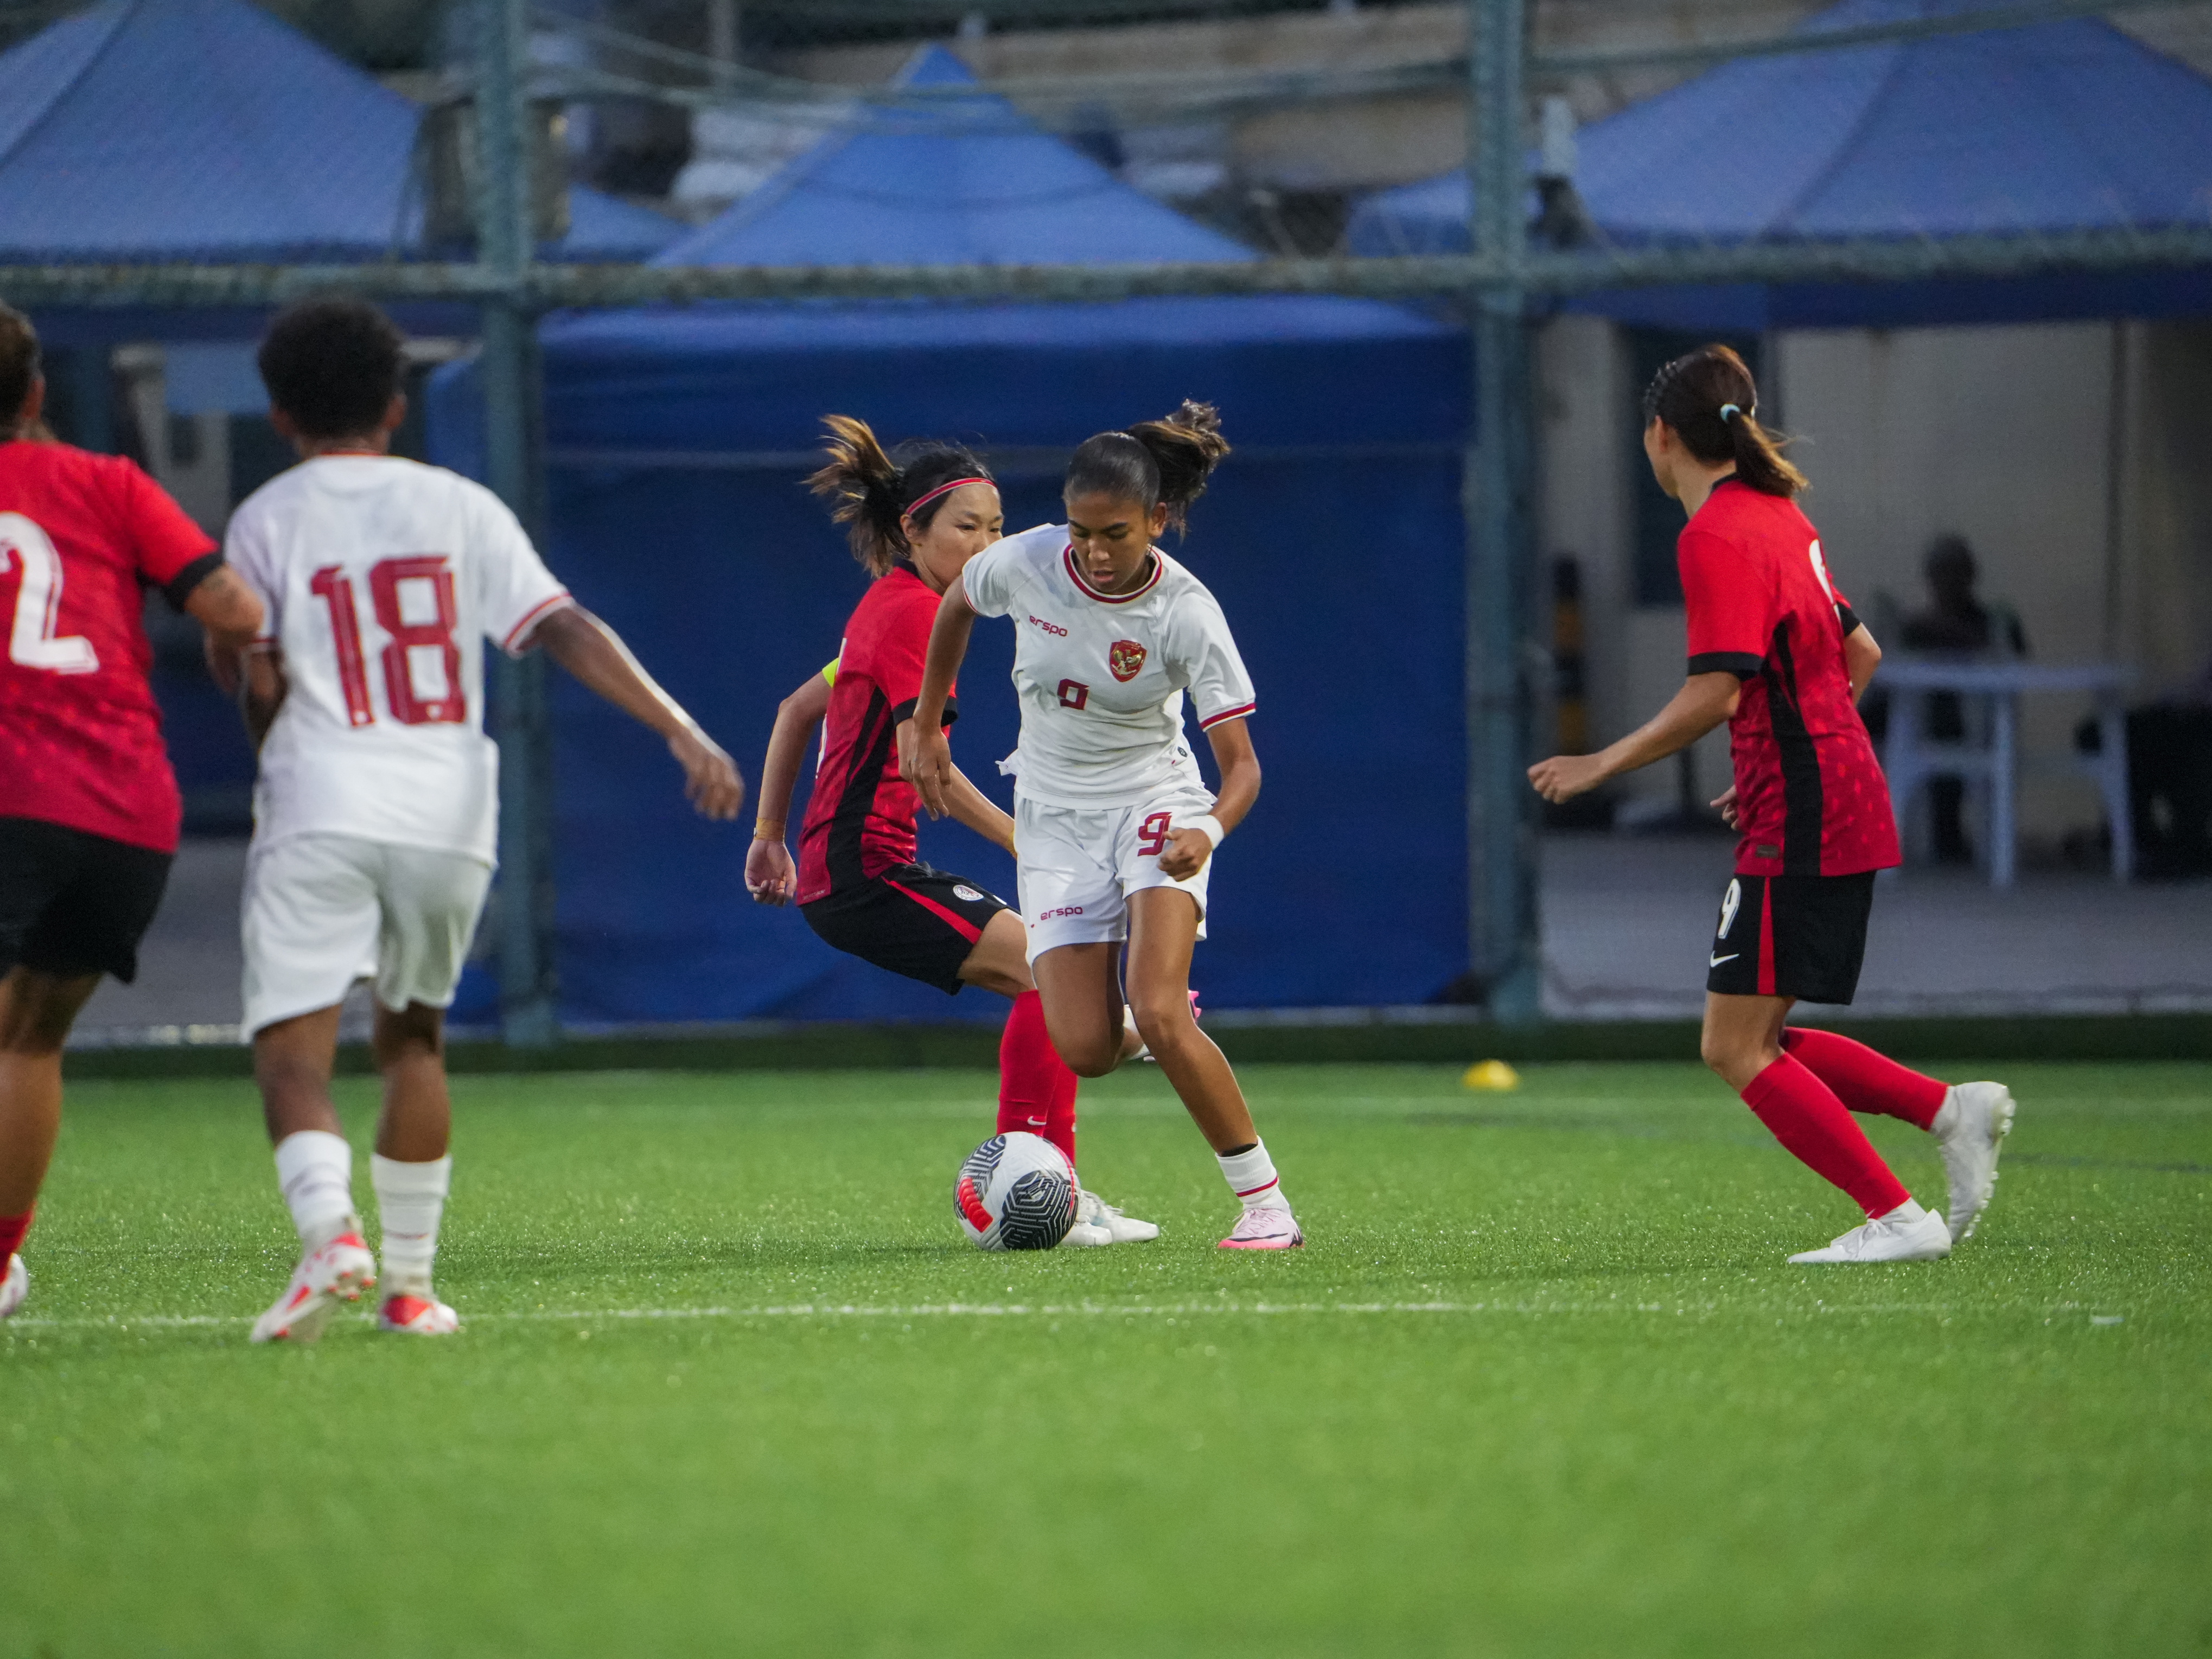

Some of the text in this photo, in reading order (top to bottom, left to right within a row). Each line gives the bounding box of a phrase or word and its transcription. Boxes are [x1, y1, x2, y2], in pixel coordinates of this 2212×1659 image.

[0, 510, 99, 673] 2
[311, 557, 466, 726] 18
[1029, 615, 1068, 637] erspo
[1137, 812, 1172, 857] 9
[1041, 907, 1083, 921] erspo
[1718, 878, 1741, 939] 9
